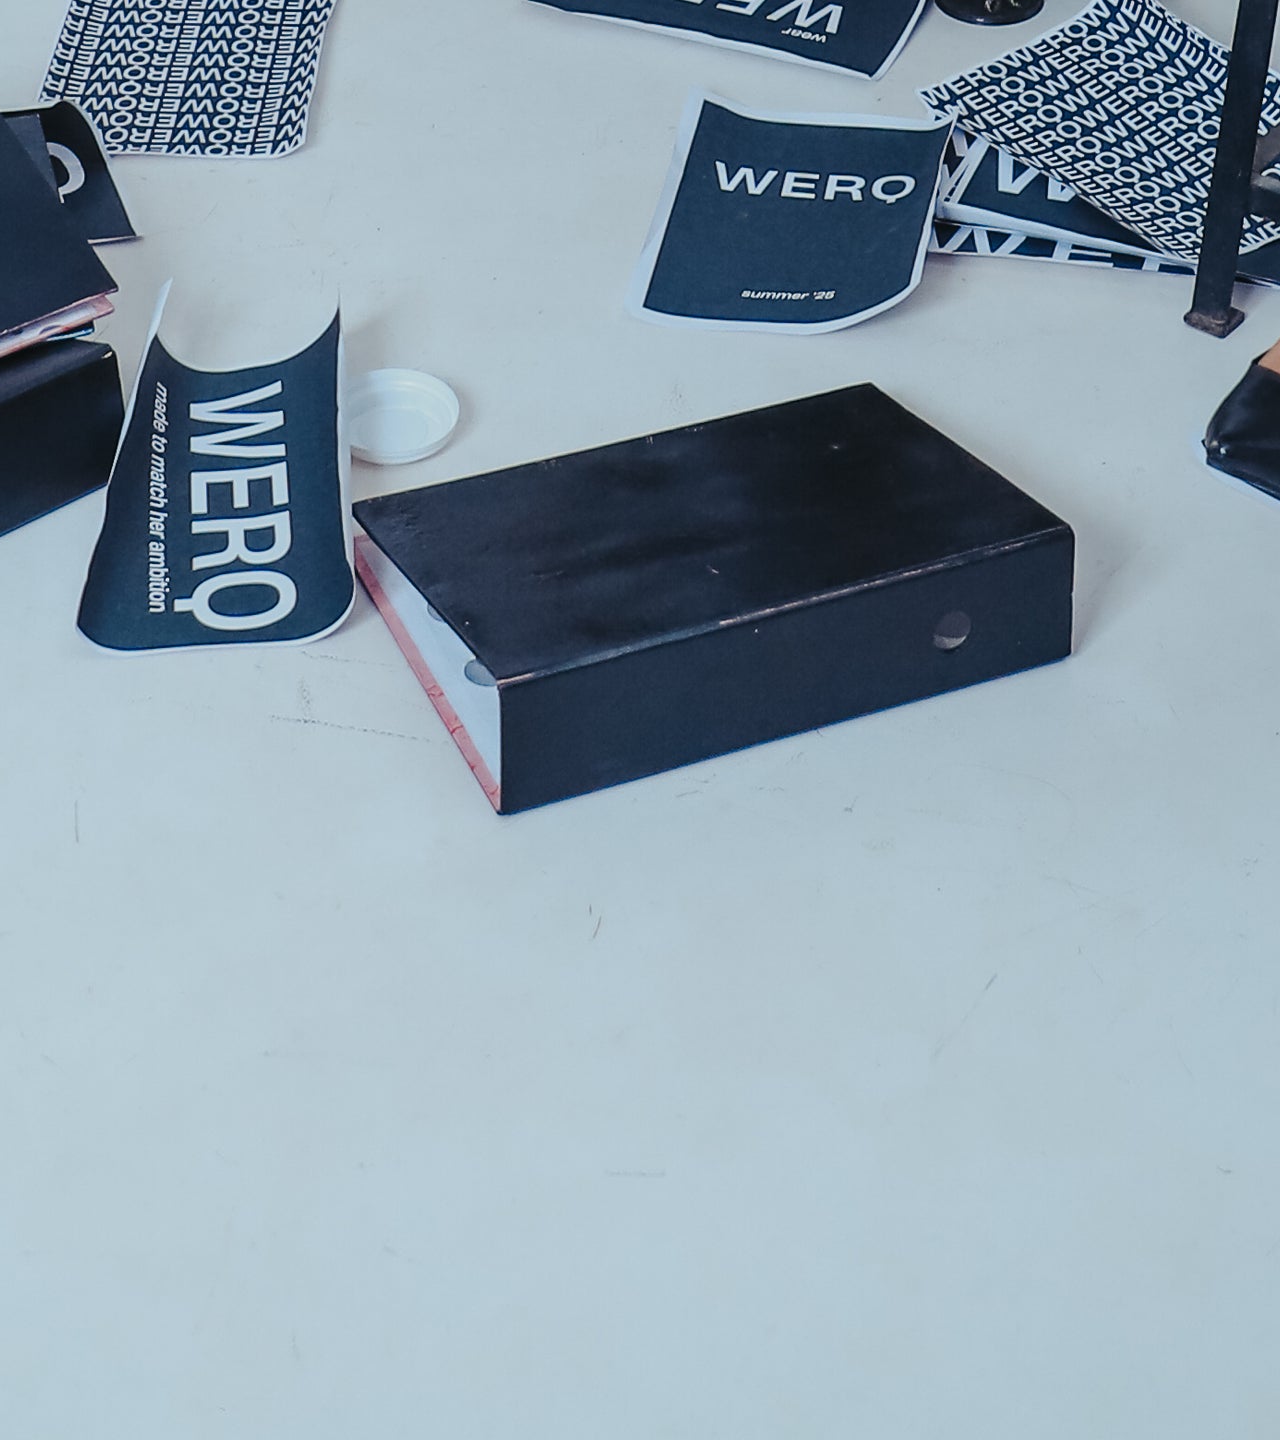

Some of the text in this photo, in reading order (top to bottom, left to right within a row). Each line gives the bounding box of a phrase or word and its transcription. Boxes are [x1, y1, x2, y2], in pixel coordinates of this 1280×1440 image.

[781, 28, 827, 43] wear
[715, 160, 915, 204] WERQ
[741, 290, 810, 301] summer
[148, 381, 170, 614] made to match her ambition
[173, 380, 297, 631] WERQ
